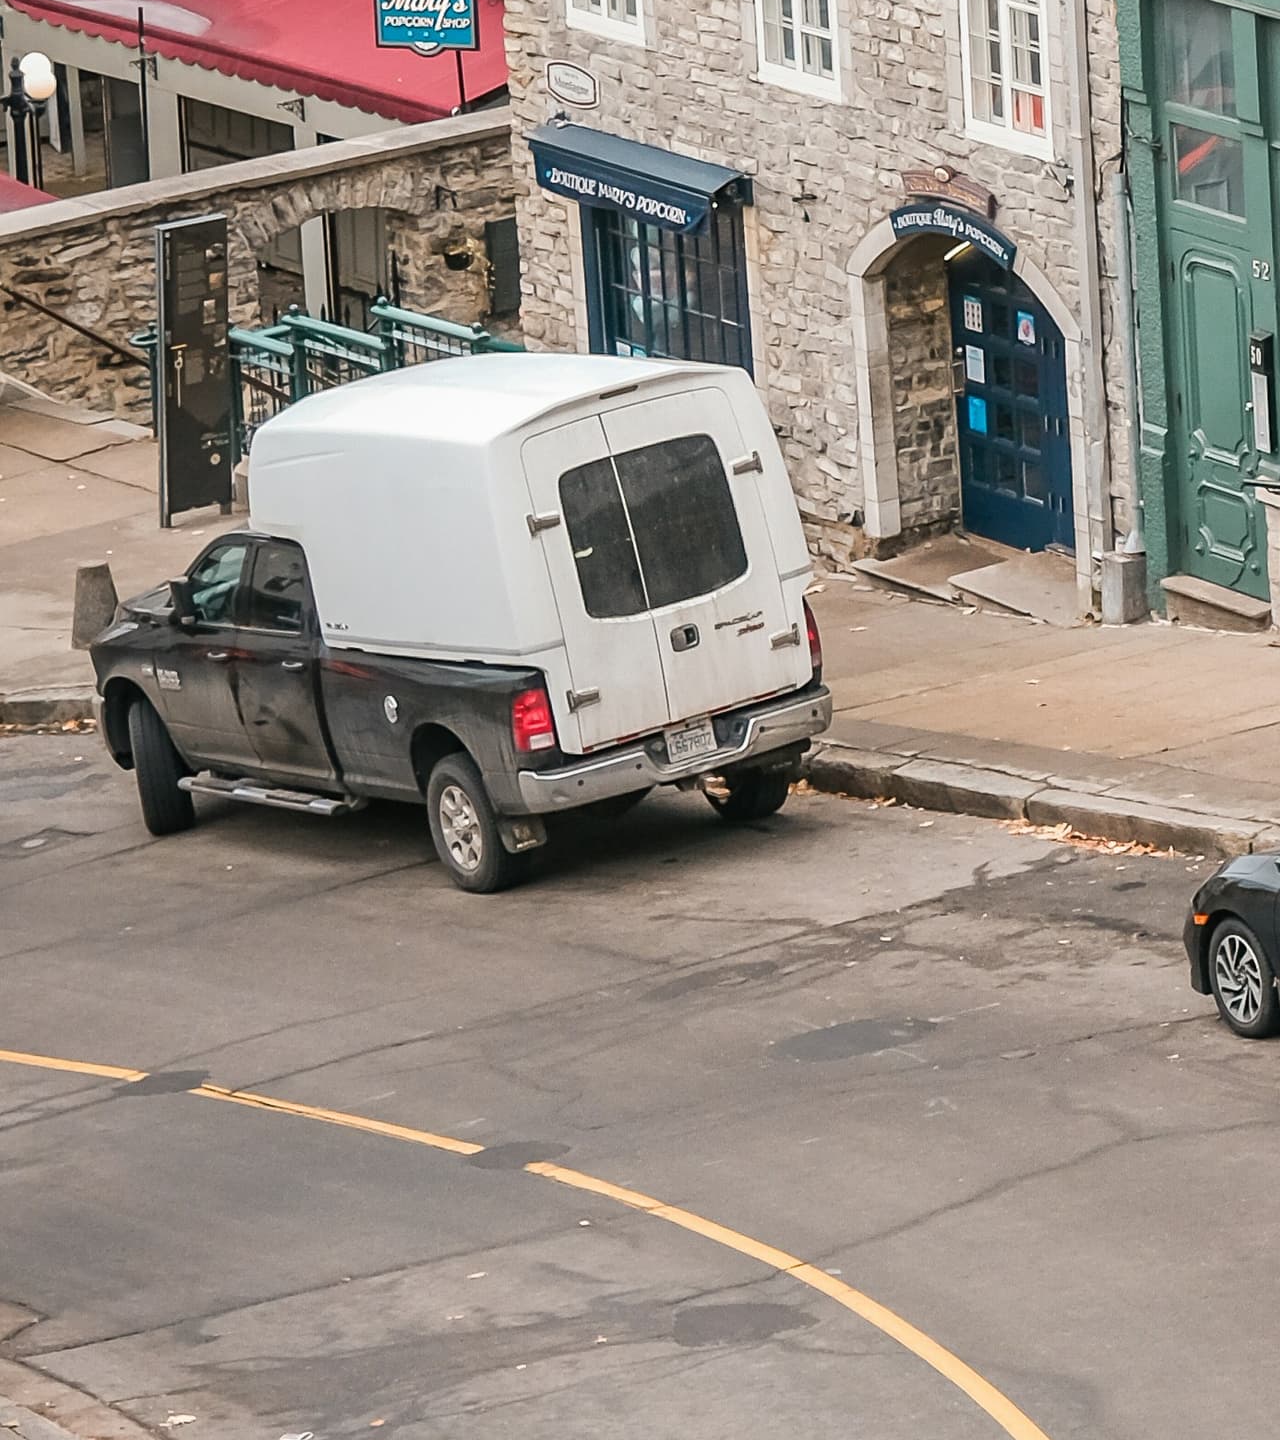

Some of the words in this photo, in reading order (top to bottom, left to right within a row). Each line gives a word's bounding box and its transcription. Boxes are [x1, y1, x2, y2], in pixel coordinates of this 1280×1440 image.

[383, 16, 434, 28] POPCORN
[551, 167, 597, 196] BOUTIQUE
[636, 195, 687, 225] POPCORN
[1251, 259, 1271, 281] 52
[1249, 344, 1262, 367] 50
